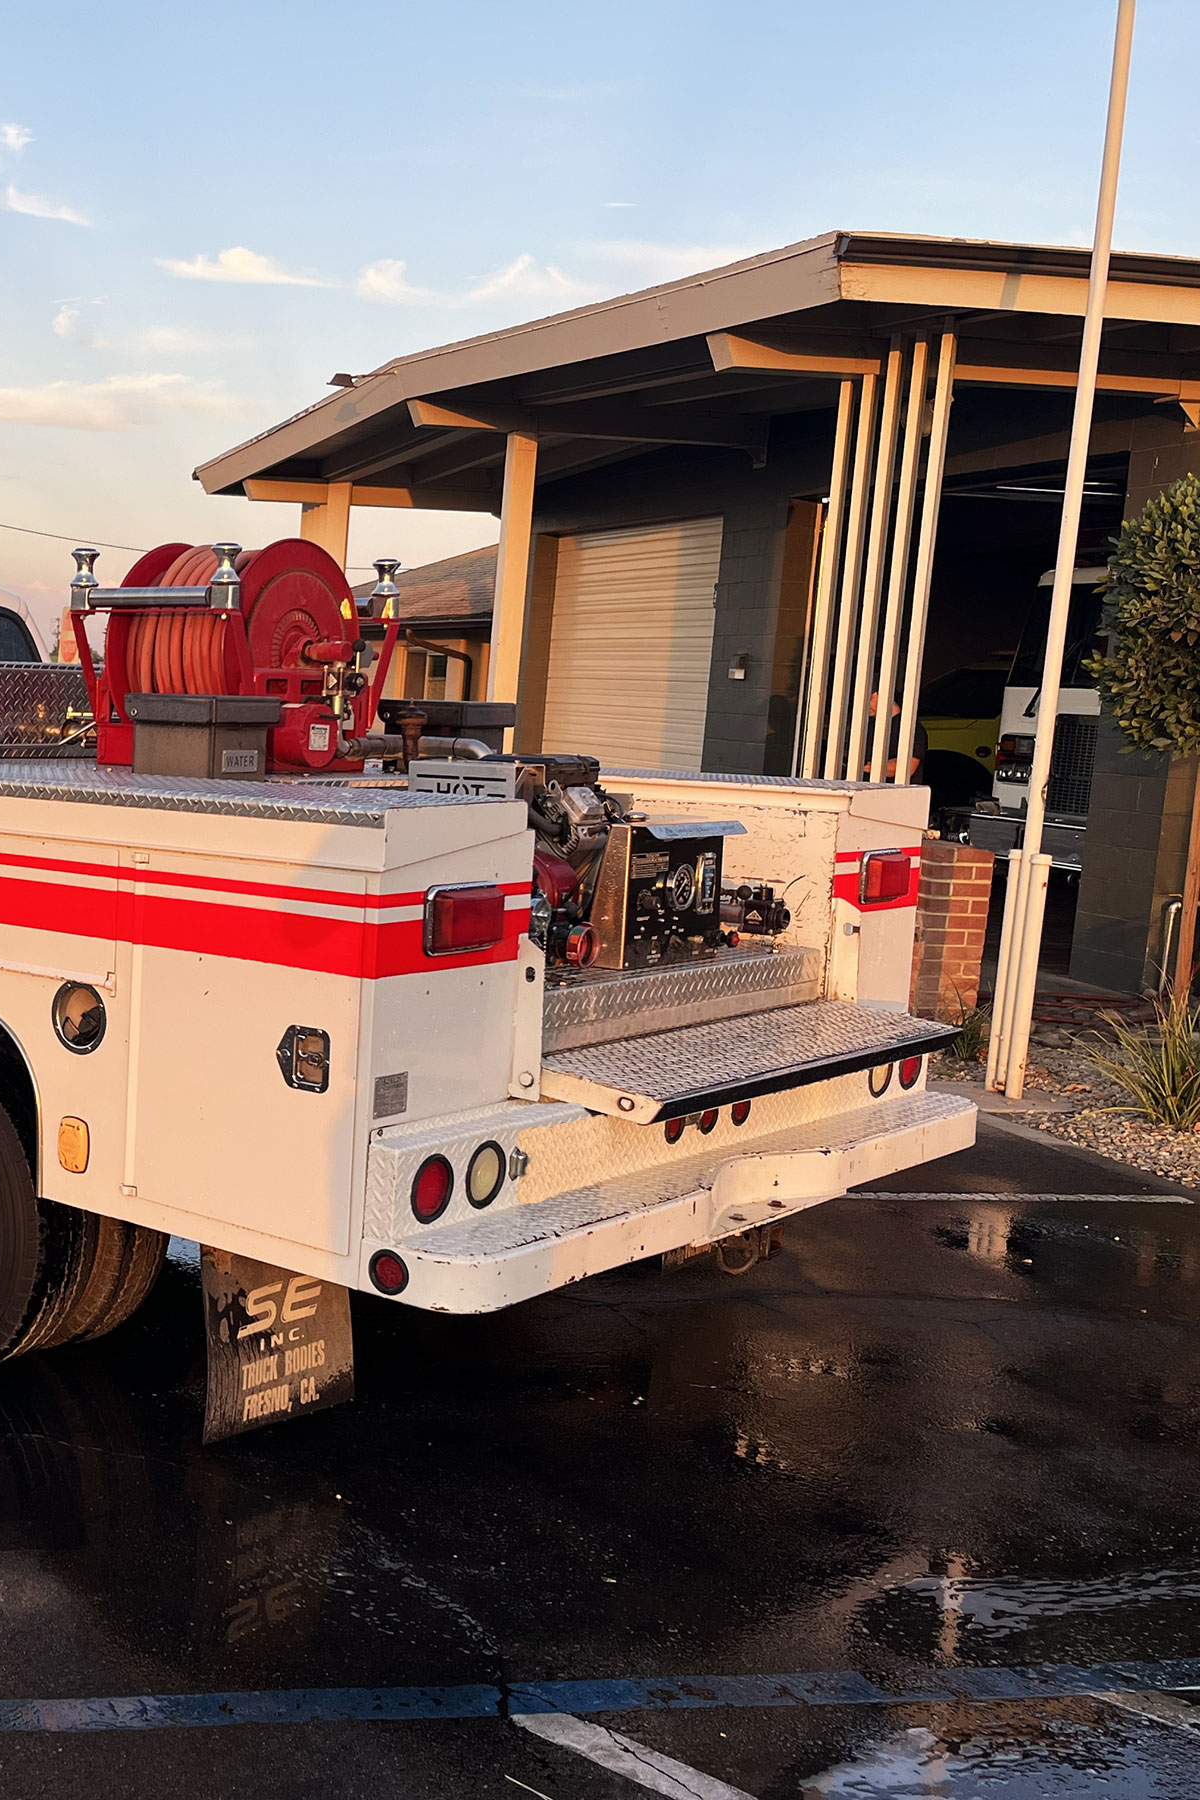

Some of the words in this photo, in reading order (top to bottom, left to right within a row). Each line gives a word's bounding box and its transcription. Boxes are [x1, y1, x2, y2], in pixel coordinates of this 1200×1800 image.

[226, 755, 255, 768] WATER
[436, 782, 485, 797] HOT
[237, 1276, 323, 1339] SE
[242, 1355, 279, 1390] TRUCK
[285, 1339, 326, 1374] BODIES
[243, 1384, 292, 1422] FRESNO,
[300, 1376, 320, 1406] CA.
